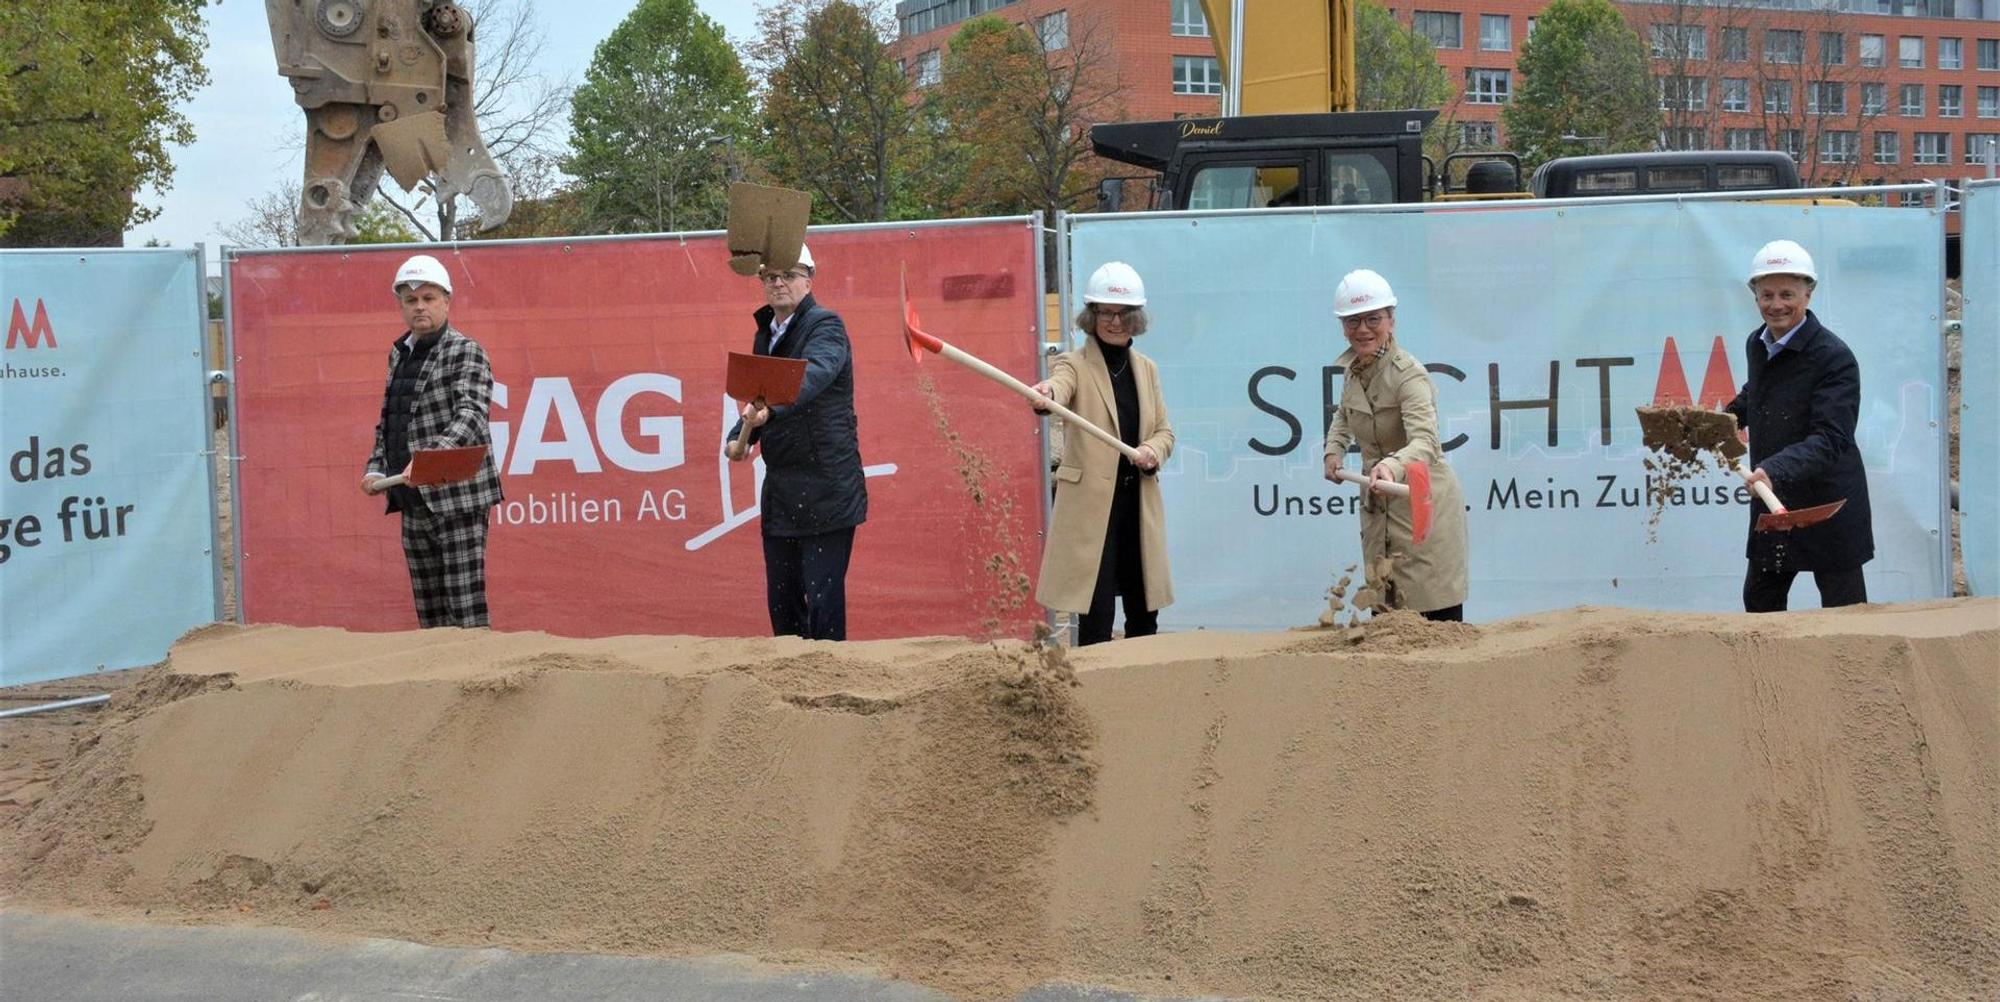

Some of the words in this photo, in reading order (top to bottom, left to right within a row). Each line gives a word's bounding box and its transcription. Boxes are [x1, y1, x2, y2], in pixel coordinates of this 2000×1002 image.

[1177, 119, 1225, 139] Daniel
[488, 372, 686, 476] AG
[9, 436, 92, 483] das
[637, 488, 687, 521] AG
[1486, 477, 1580, 510] Mein
[57, 496, 135, 542] für
